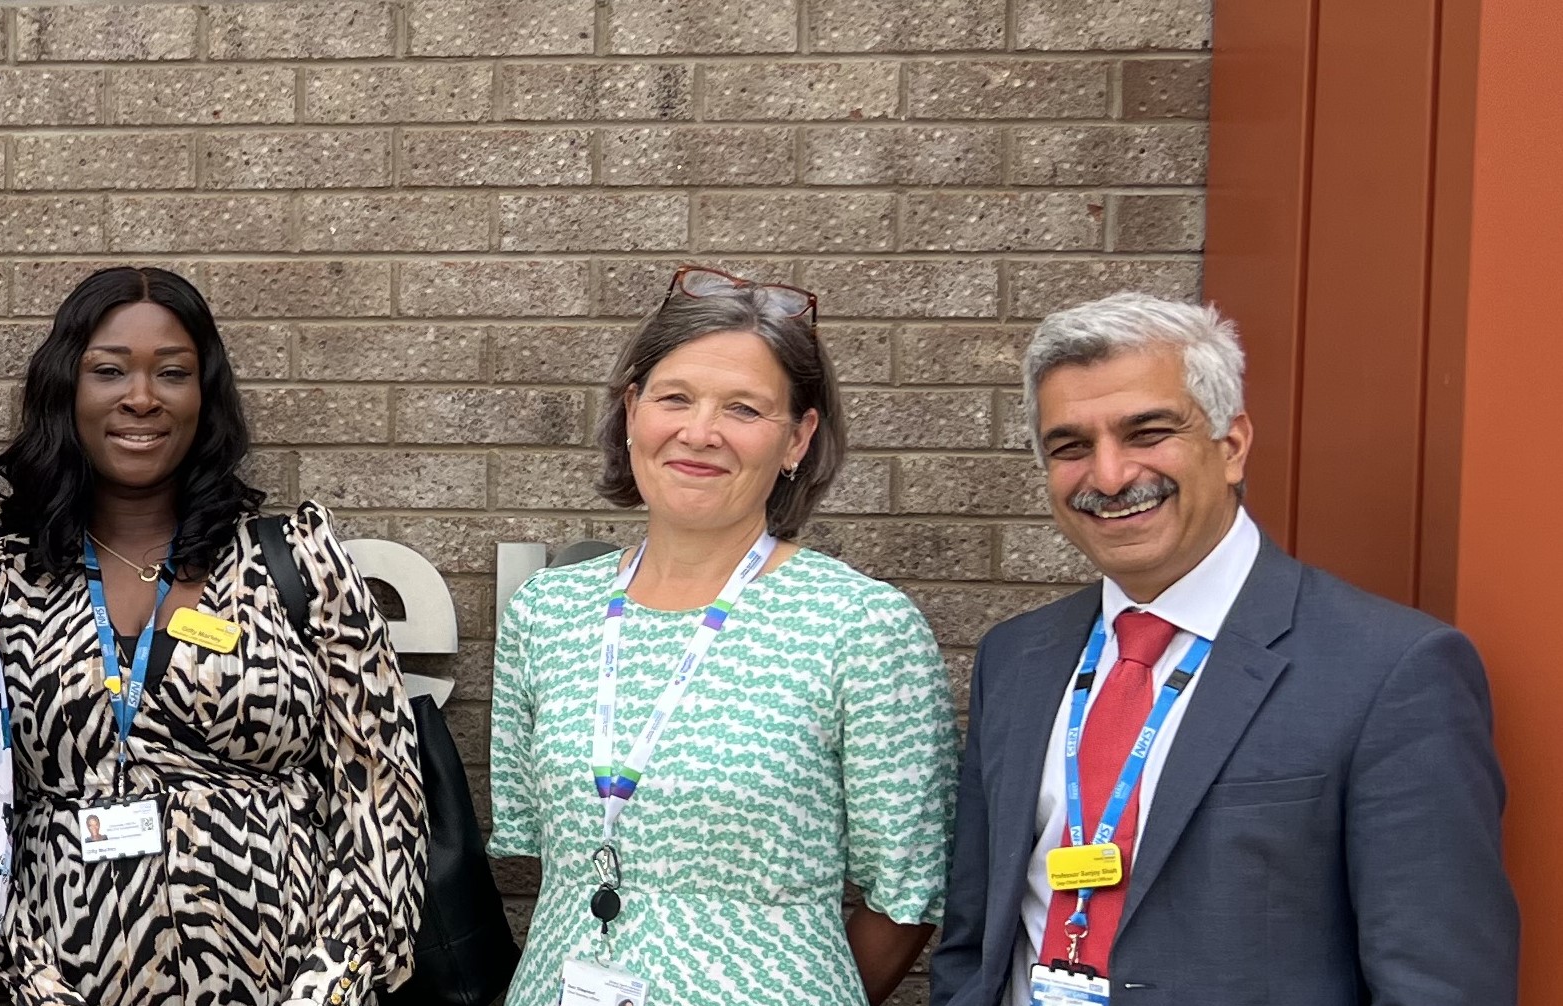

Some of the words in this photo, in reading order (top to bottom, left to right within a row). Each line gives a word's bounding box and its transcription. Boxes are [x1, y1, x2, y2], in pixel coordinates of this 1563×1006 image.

[94, 607, 108, 626] NHS
[128, 682, 142, 708] NHS
[1133, 728, 1154, 757] NHS
